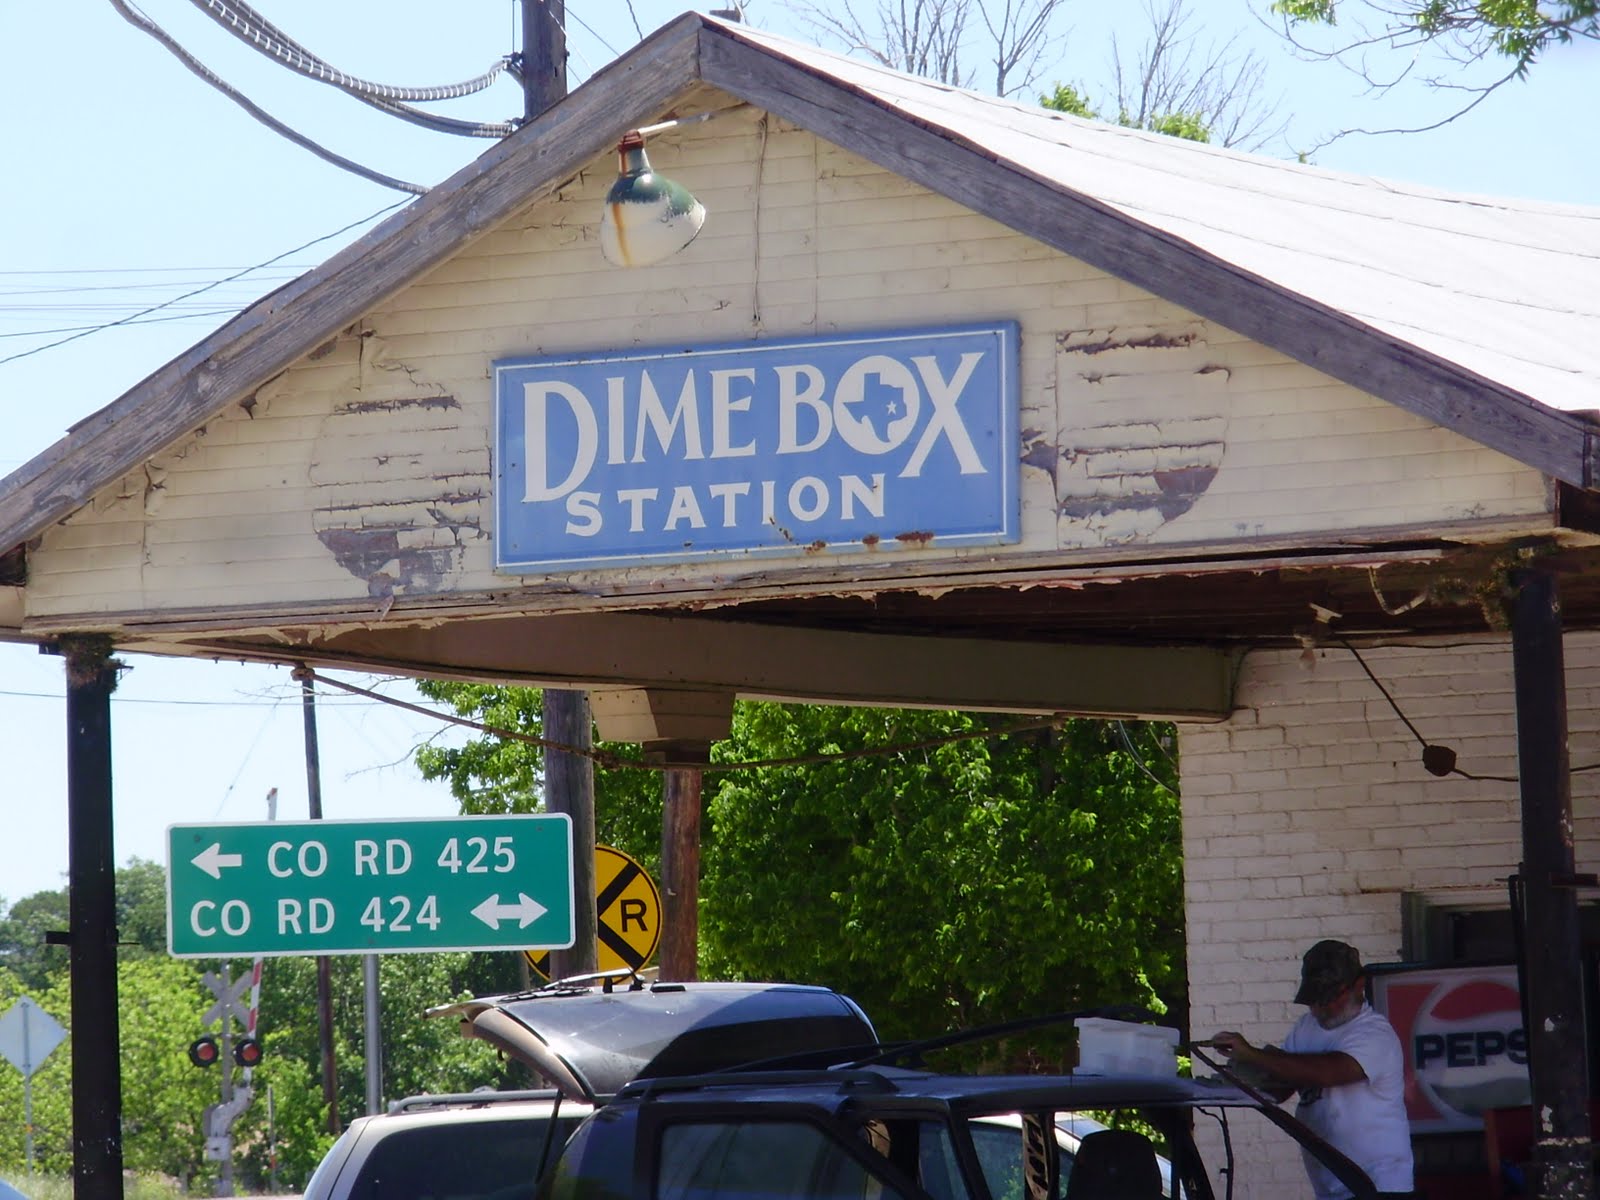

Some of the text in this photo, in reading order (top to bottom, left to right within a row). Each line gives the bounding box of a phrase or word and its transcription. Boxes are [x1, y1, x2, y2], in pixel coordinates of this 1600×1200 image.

[522, 352, 988, 503] DIME BOX
[565, 473, 886, 537] STATION
[267, 836, 516, 878] CO RD 425
[190, 895, 442, 937] CO RD 424
[620, 898, 649, 933] R
[1415, 1028, 1527, 1070] PEPS
